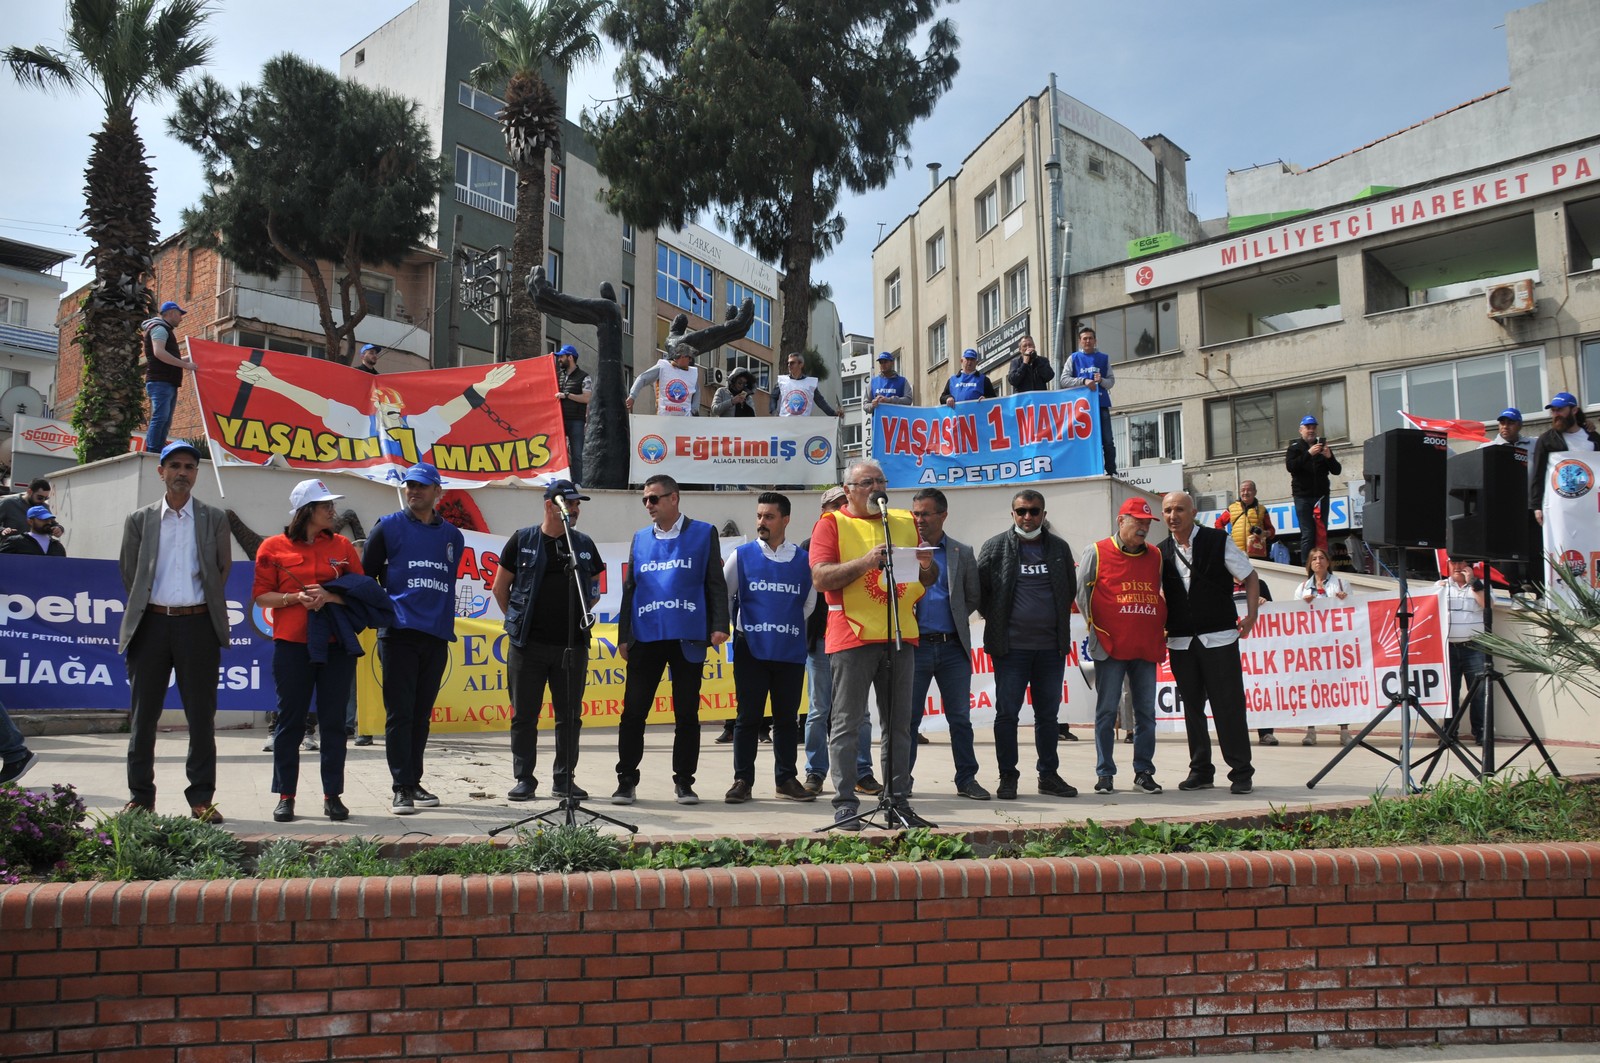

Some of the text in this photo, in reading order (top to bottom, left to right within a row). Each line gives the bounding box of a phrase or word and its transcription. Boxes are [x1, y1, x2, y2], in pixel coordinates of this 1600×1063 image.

[1221, 157, 1600, 266] MİLLİYETÇİ HAREKET PA
[688, 232, 721, 260] TARKAN
[1139, 237, 1159, 247] EGE
[984, 333, 1003, 351] YÜCEL
[1003, 317, 1027, 340] İNŞAAT
[987, 404, 1011, 452] 1
[1015, 397, 1093, 447] MAYIS
[1424, 436, 1446, 446] 2000
[385, 426, 552, 474] 1 MAYIS
[918, 455, 1053, 484] A-PETDER
[640, 557, 692, 573] GÖREVLİ
[1021, 564, 1049, 575] ESTE
[749, 579, 801, 595] GÖREVLİ
[1121, 580, 1154, 592] DİSK
[1116, 592, 1159, 605] EMEKLİ-SEN
[1119, 602, 1157, 616] ALİAĞA
[32, 633, 74, 643] PETROL
[77, 635, 110, 645] KİMYA
[1241, 637, 1362, 676] ALK PARTİSİ
[1276, 680, 1306, 717] İLÇE
[1311, 676, 1369, 709] ÖRGÜTÜ
[431, 705, 459, 723] EL
